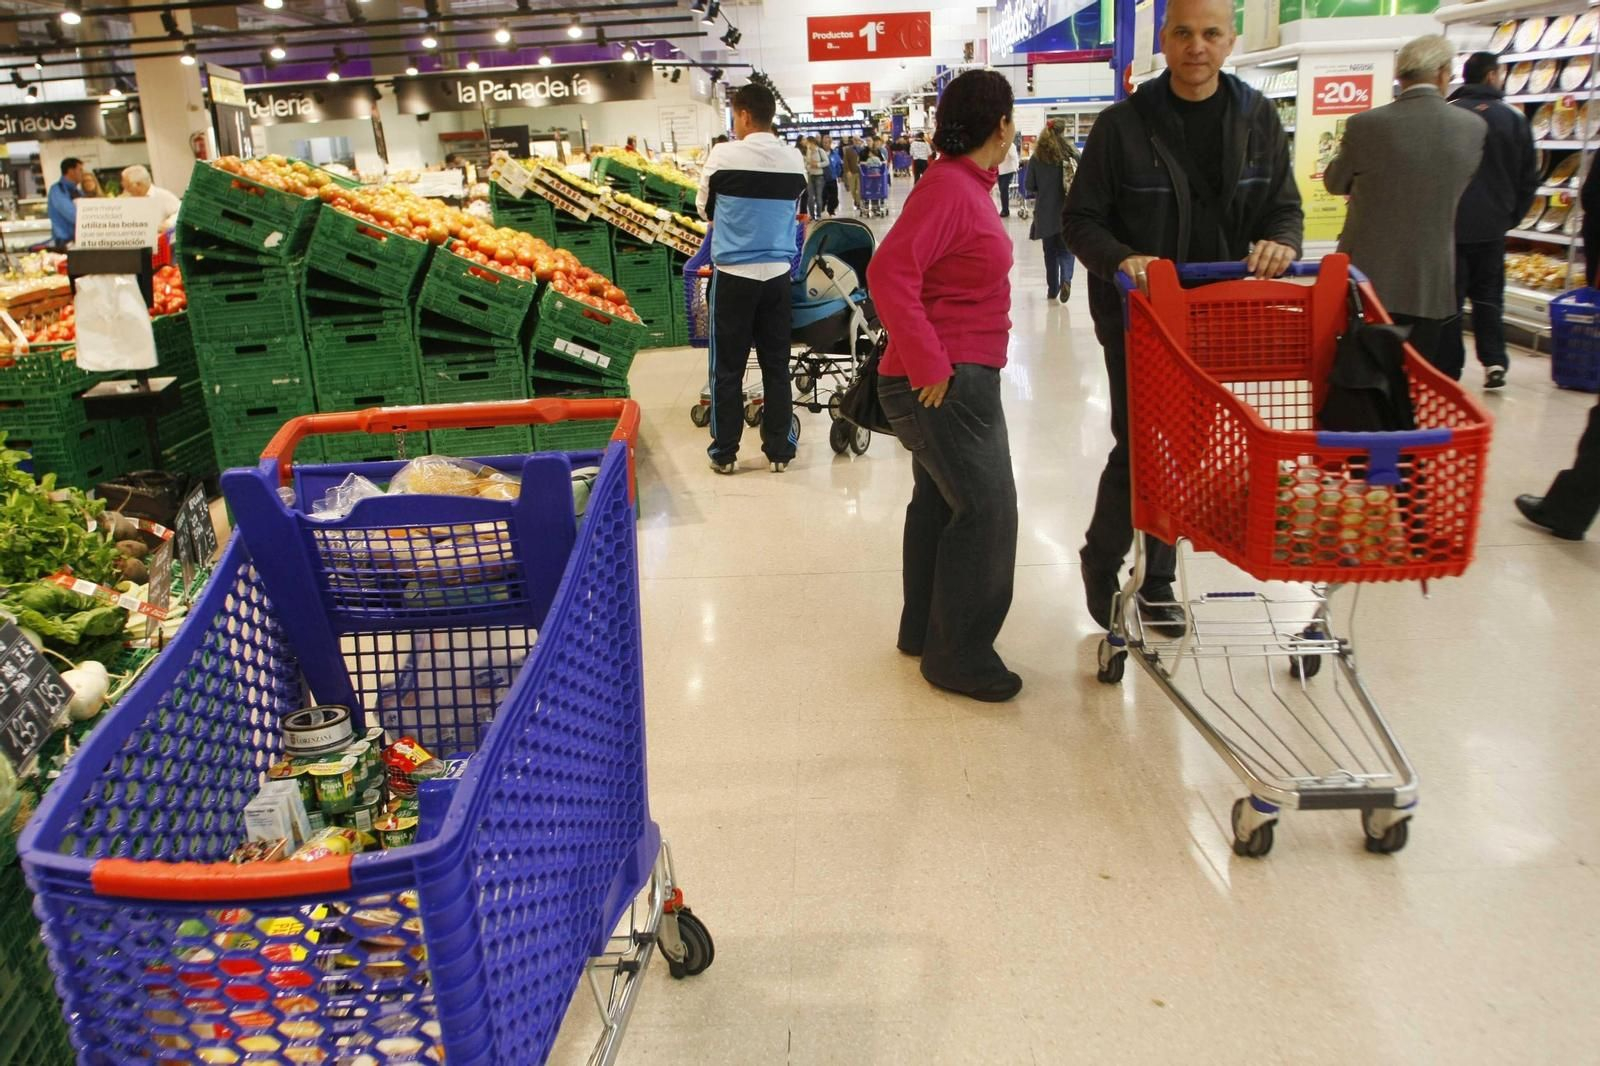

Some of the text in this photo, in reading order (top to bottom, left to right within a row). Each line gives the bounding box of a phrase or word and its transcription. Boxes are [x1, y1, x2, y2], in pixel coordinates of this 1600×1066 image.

[812, 31, 854, 40] Productos
[457, 74, 592, 103] la Panadería
[1317, 81, 1369, 104] -20%
[81, 220, 148, 229] utiliza las bolsas
[97, 238, 145, 247] disposición
